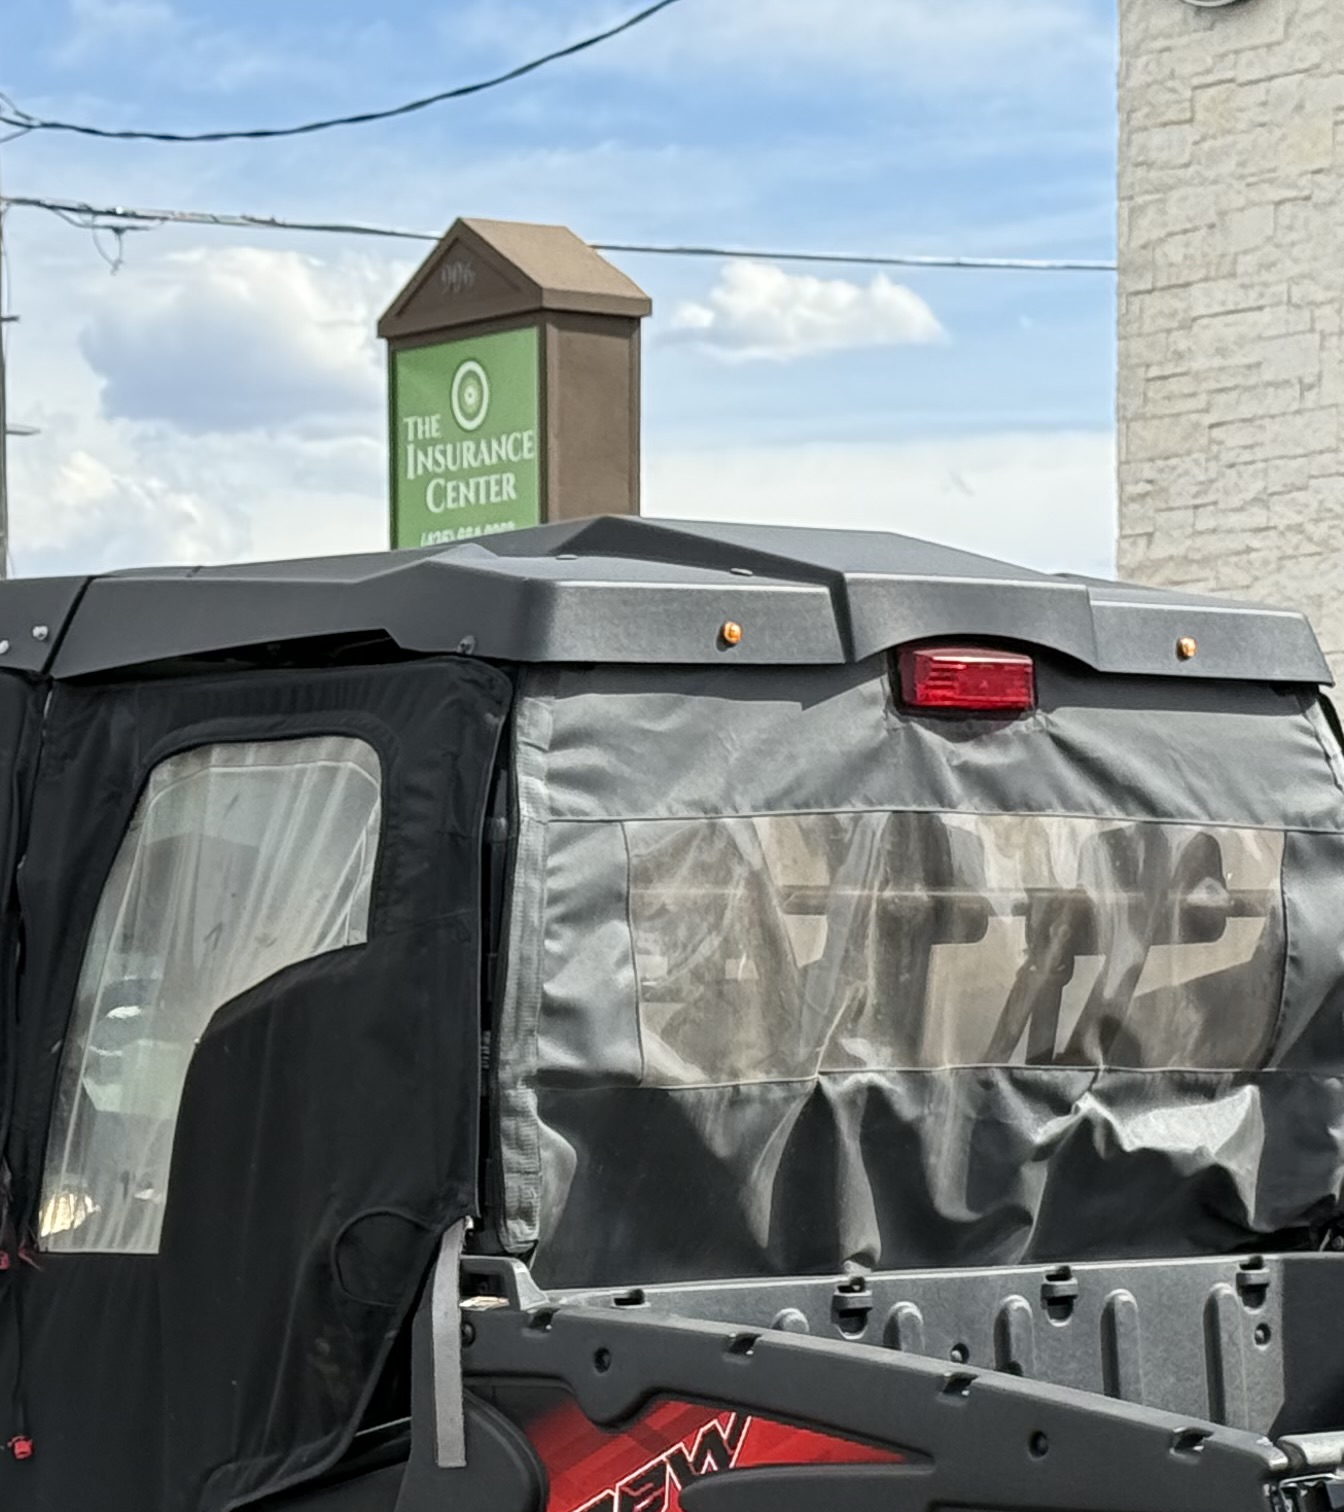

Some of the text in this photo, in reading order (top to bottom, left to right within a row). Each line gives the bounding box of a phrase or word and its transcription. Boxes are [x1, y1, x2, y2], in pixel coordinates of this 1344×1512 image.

[403, 413, 441, 442] THE
[406, 429, 536, 480] INSURANCE
[426, 472, 517, 513] CENTER
